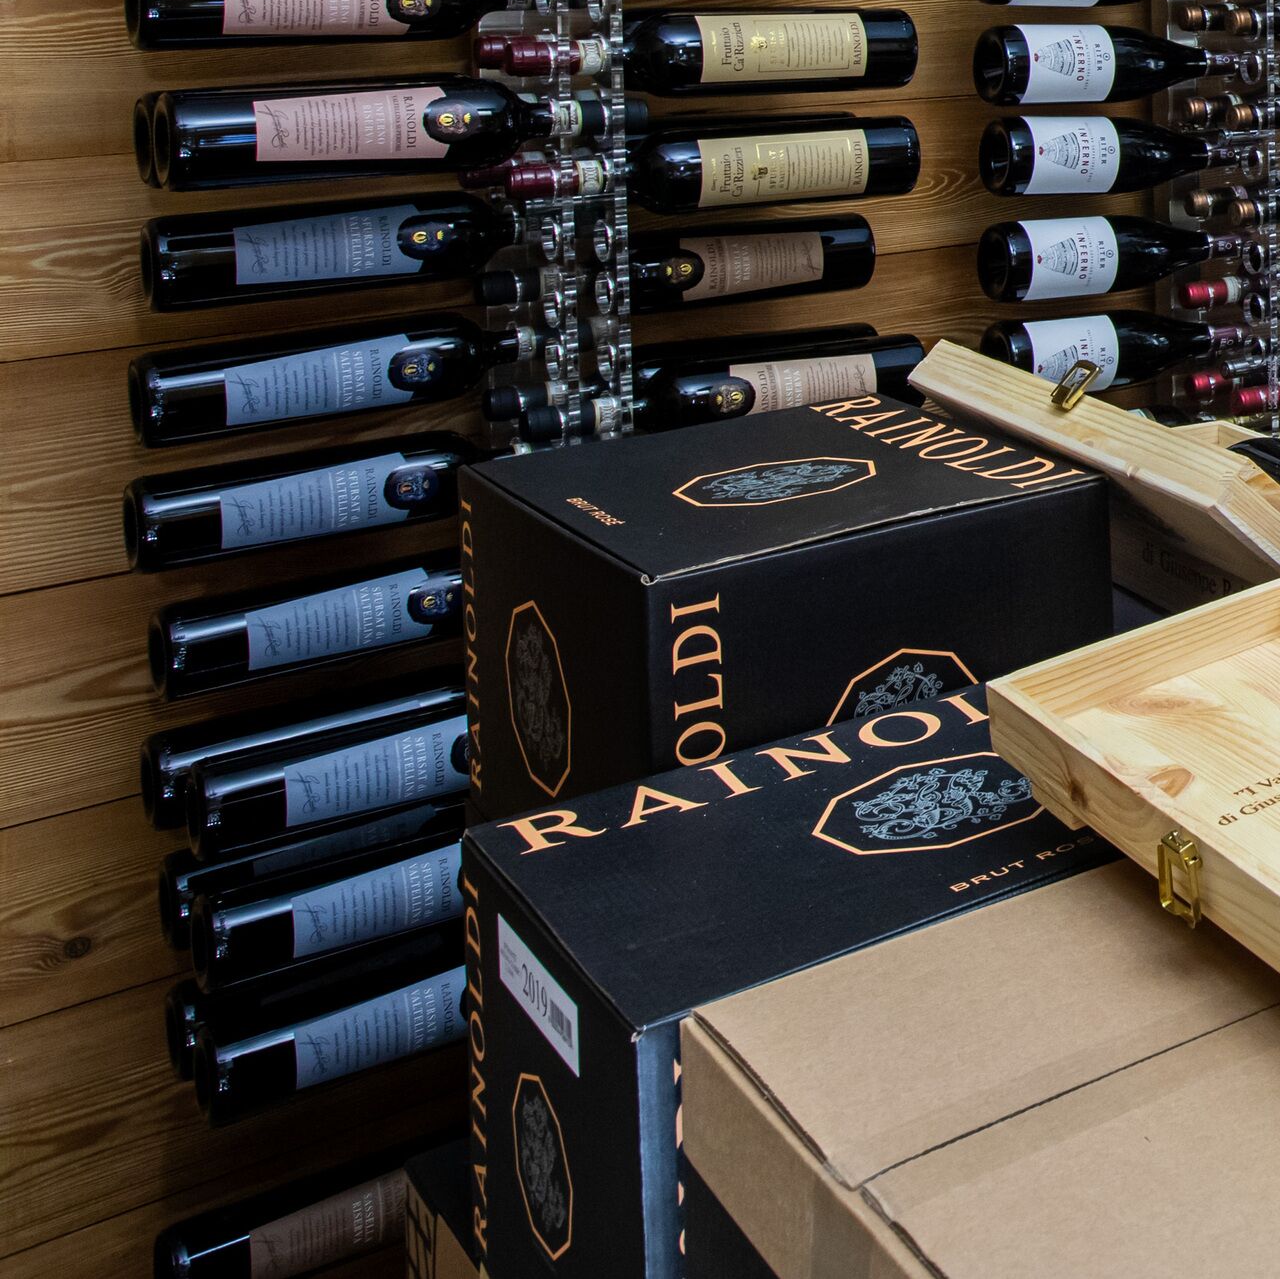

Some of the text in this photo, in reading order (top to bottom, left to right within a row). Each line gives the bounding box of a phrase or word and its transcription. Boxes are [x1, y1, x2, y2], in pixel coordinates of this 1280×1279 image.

[403, 95, 417, 150] RAINOLDI
[720, 154, 731, 194] Fruttaio
[852, 141, 862, 185] RAINOLDI
[1077, 127, 1088, 176] INFERNO
[338, 350, 351, 409] VALTELLINA
[353, 350, 364, 393] SFURSAT
[369, 348, 382, 401] RAINOLDI
[811, 395, 1084, 490] RAINOLDI
[334, 470, 347, 529] VALTELLINA
[348, 470, 359, 513] SFURSAT
[366, 468, 378, 520] RAINOLDI
[359, 586, 373, 646] VALTELLINA
[390, 583, 402, 637] RAINOLDI
[460, 500, 483, 793] RAINOLDI
[432, 732, 444, 787] RAINOLDI
[1218, 811, 1239, 827] di
[949, 834, 1096, 894] BRUT ROS
[520, 963, 551, 1019] 2019
[463, 874, 490, 1251] RAINOLDI
